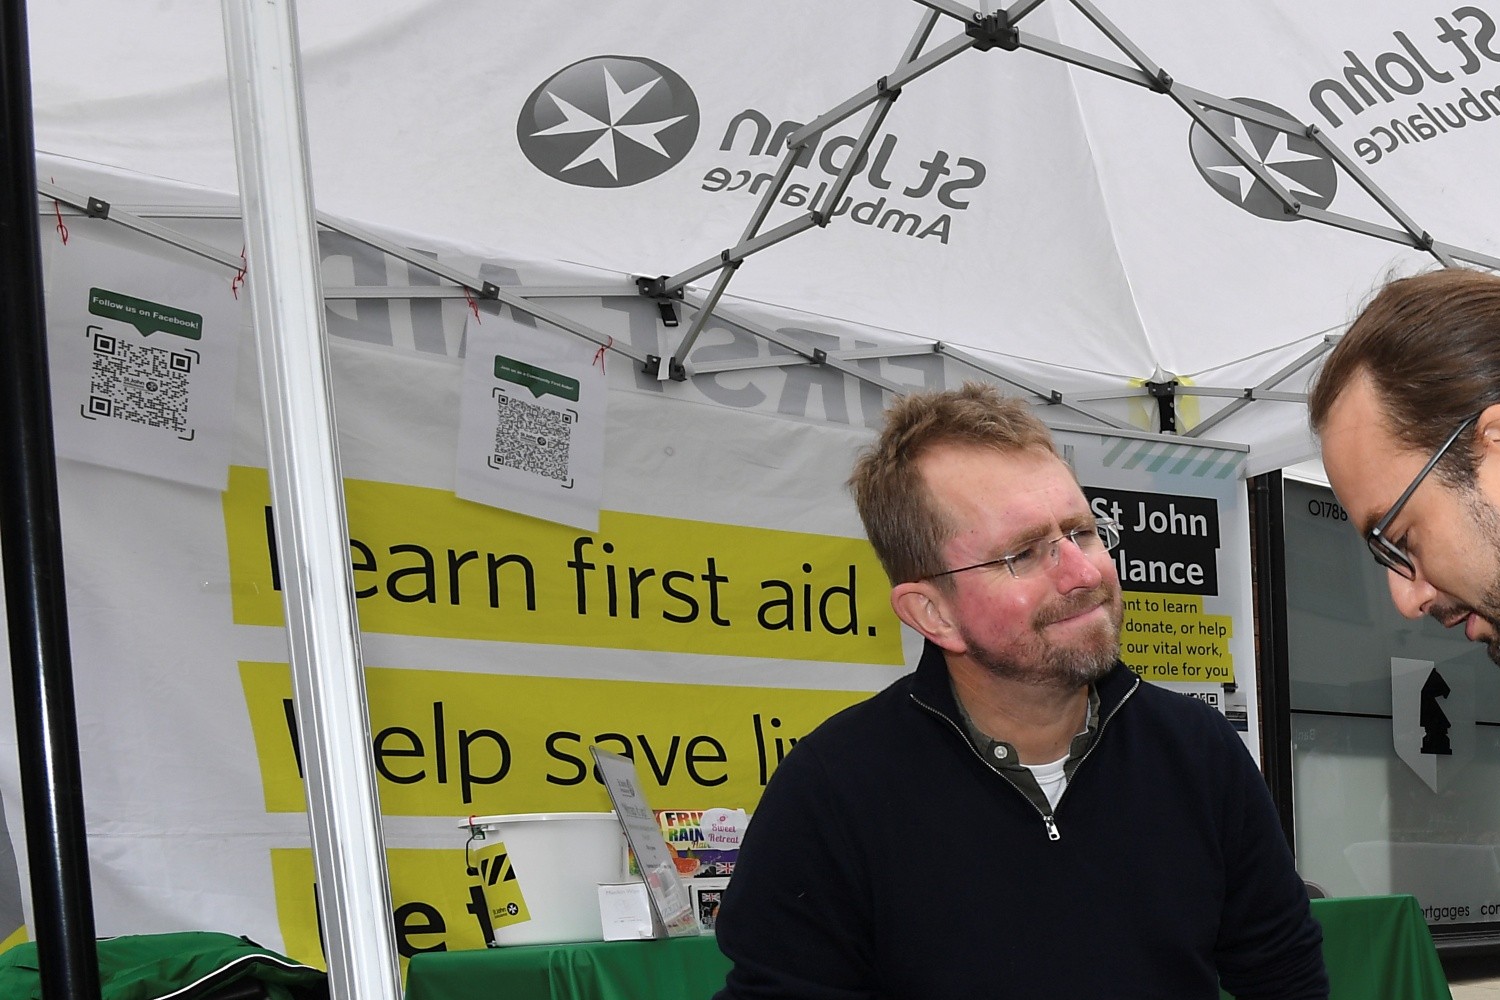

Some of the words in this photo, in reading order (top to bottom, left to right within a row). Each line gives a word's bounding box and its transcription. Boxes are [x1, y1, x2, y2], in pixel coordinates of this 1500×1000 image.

[93, 296, 124, 310] Follow
[126, 305, 137, 314] us
[139, 309, 150, 317] on
[153, 311, 199, 329] Facebook!
[1091, 497, 1124, 531] St
[1133, 501, 1208, 537] John
[1111, 549, 1204, 586] lance
[568, 536, 731, 628] first
[756, 563, 877, 637] aid.
[1146, 599, 1159, 612] to
[1163, 599, 1198, 614] learn
[1126, 619, 1177, 636] donate,
[1181, 624, 1194, 635] or
[1199, 622, 1227, 639] help
[1127, 644, 1149, 653] our
[1152, 642, 1182, 654] vital
[1186, 642, 1223, 657] work,
[1153, 663, 1178, 675] role
[1183, 662, 1201, 676] for
[1205, 666, 1229, 679] you
[712, 823, 736, 833] Sweet
[708, 833, 739, 844] Retreat
